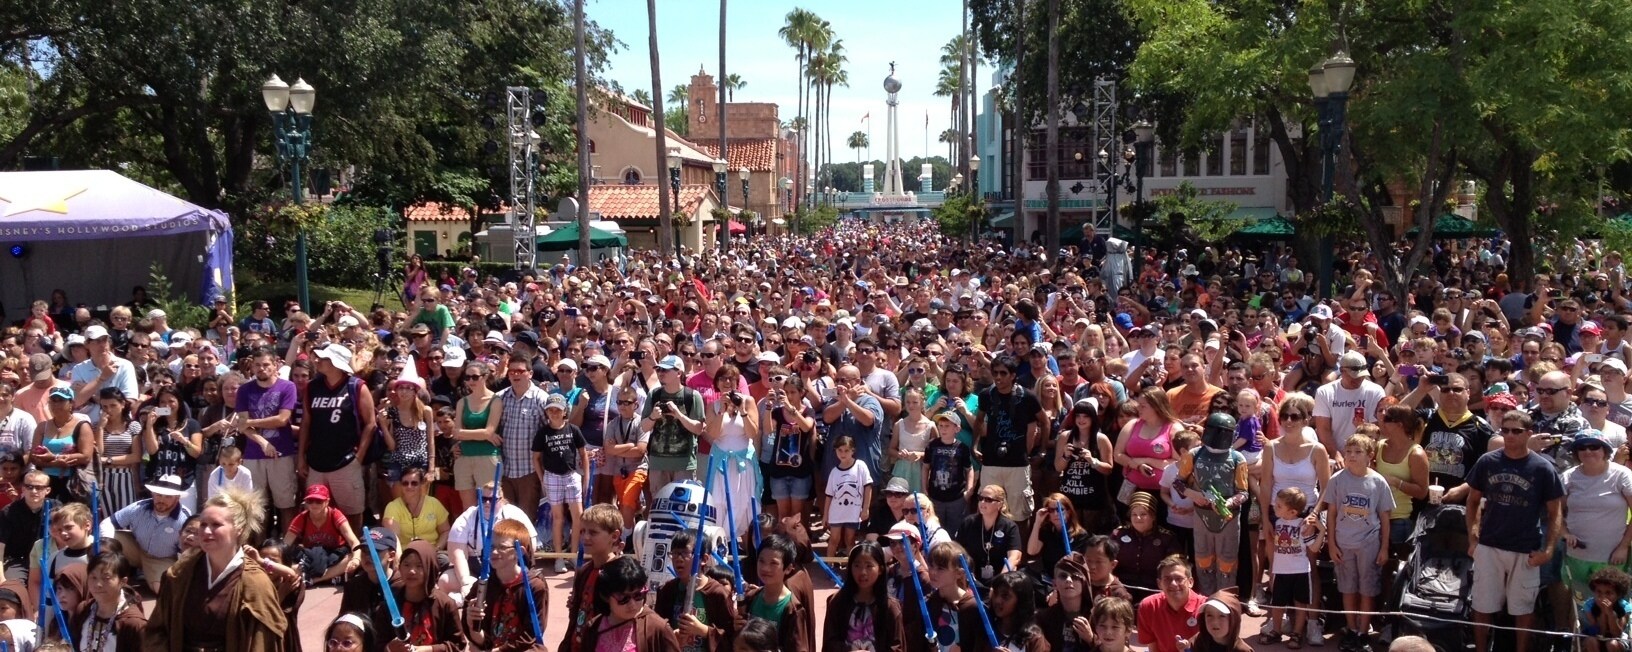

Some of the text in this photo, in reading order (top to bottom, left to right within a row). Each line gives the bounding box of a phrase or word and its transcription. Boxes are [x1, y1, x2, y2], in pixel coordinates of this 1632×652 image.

[0, 218, 199, 236] ISNEY'S HOLLYWOOD STUDIOS
[311, 396, 346, 408] HEAT
[1332, 399, 1358, 408] Hurley
[330, 409, 342, 423] 6
[1072, 461, 1090, 469] EEP
[1067, 468, 1091, 476] CALM
[1066, 478, 1085, 488] KILL
[1342, 495, 1370, 509] JEDI
